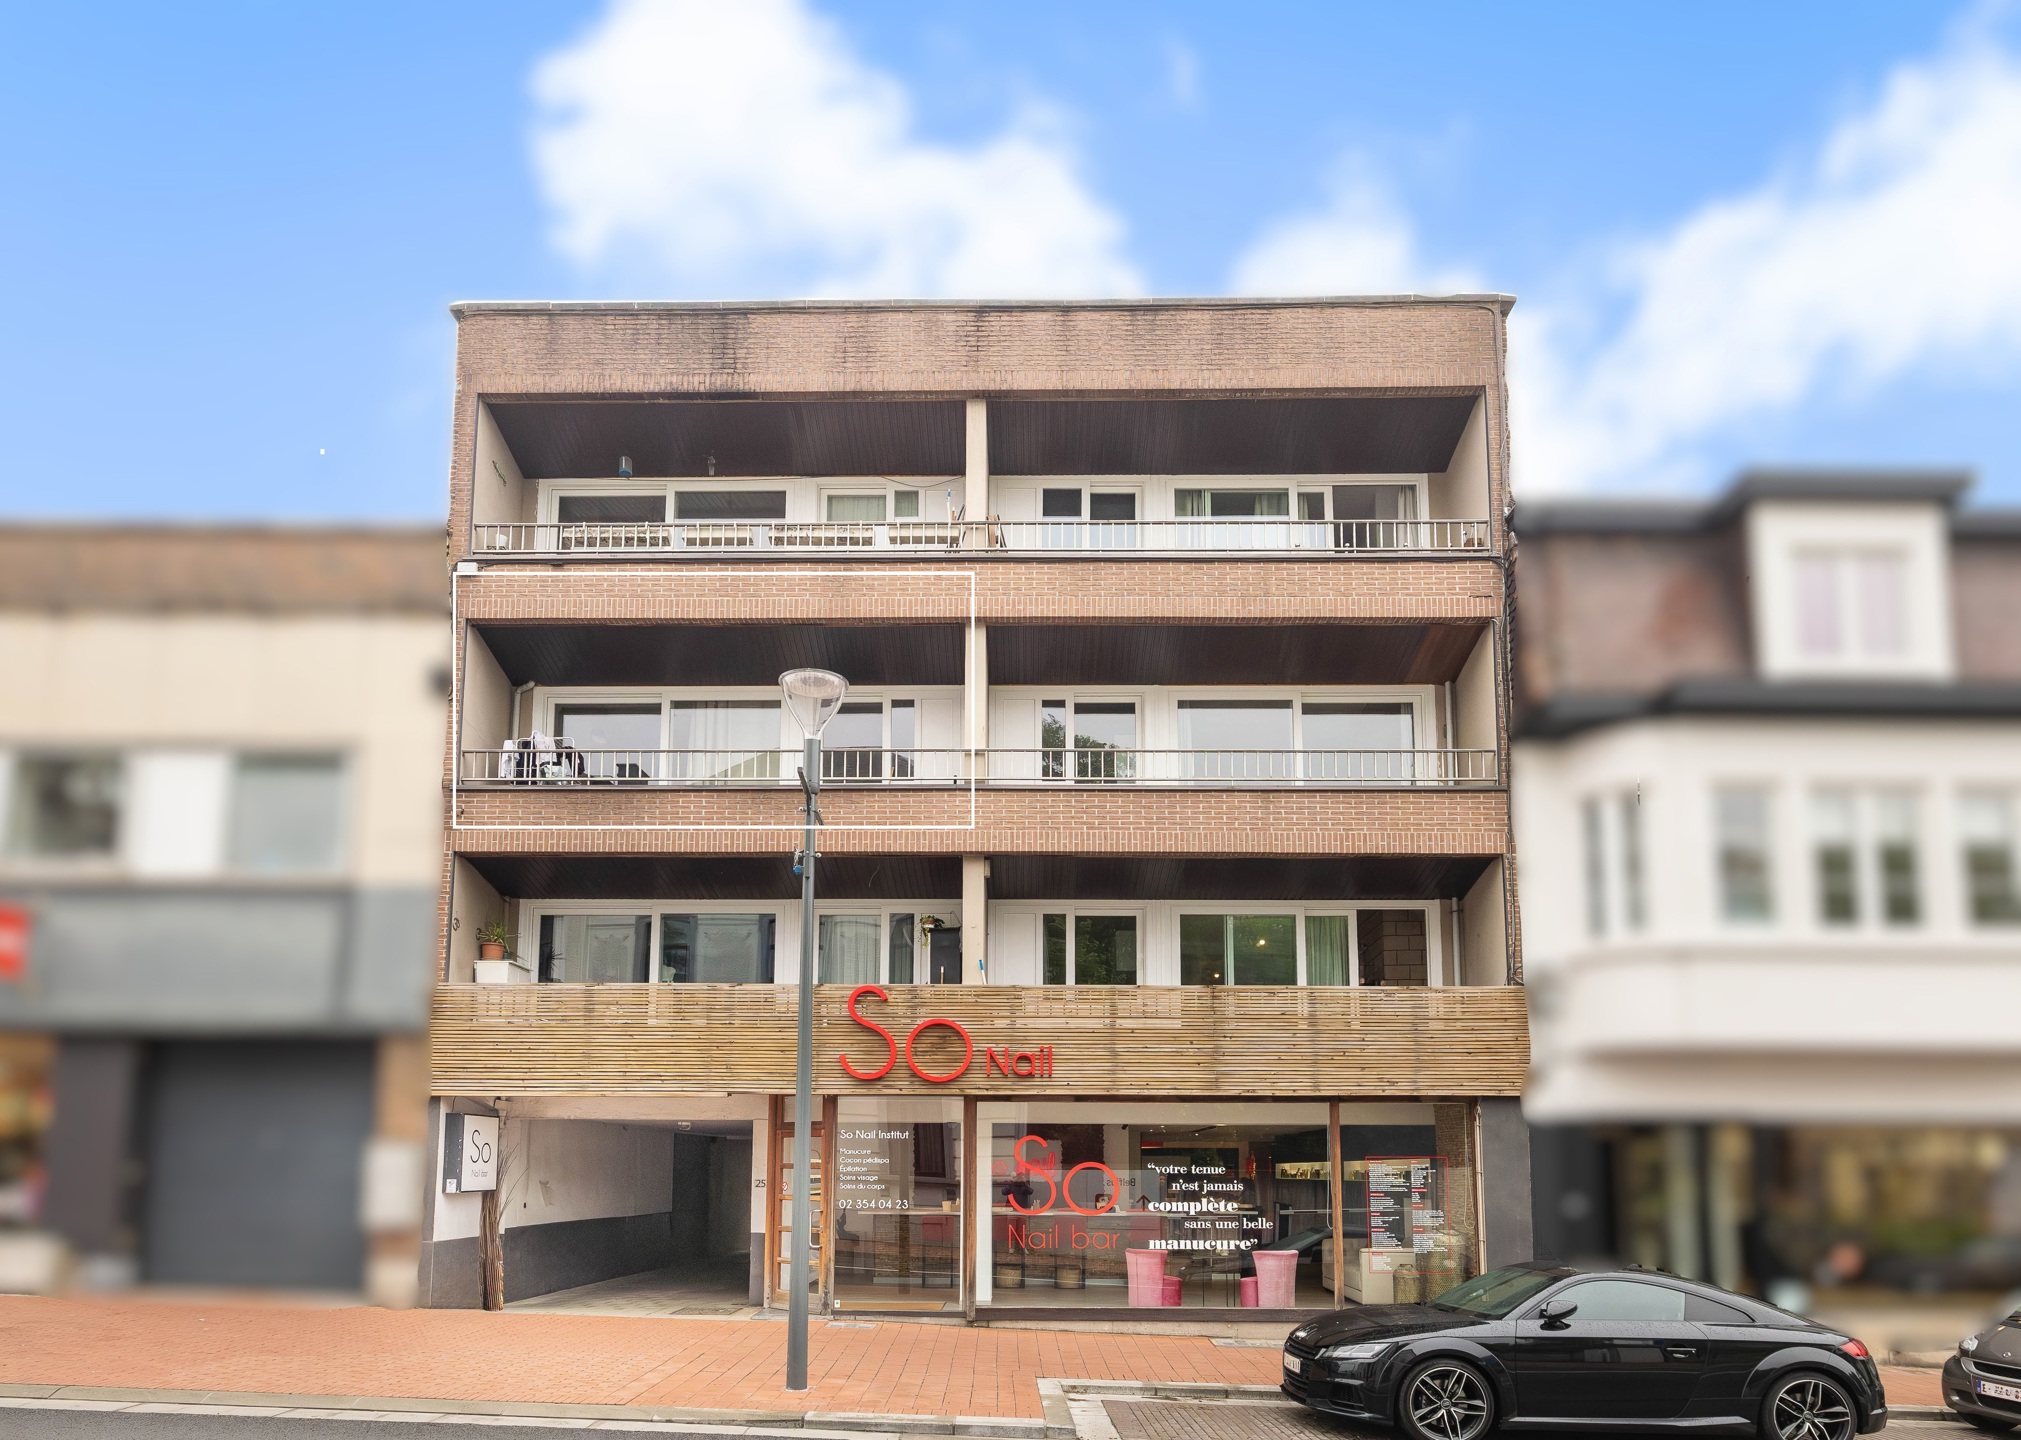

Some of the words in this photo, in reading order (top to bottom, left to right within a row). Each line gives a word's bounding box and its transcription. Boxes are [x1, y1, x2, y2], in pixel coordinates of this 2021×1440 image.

[839, 985, 973, 1082] So
[986, 1046, 1053, 1077] Nail
[840, 1129, 853, 1139] So
[855, 1129, 876, 1139] Nail
[878, 1129, 909, 1139] Institut
[470, 1129, 491, 1163] So
[1008, 1135, 1120, 1216] So
[1191, 1164, 1226, 1174] tenue
[755, 1179, 766, 1188] 25
[1172, 1179, 1199, 1191] n’est
[1202, 1180, 1244, 1195] jamais
[838, 1199, 852, 1209] 02
[855, 1199, 876, 1209] 354
[878, 1199, 892, 1209] 04
[895, 1199, 909, 1210] 23
[1148, 1197, 1238, 1216] complète
[1184, 1220, 1212, 1229] sans
[1215, 1220, 1239, 1229] une
[1242, 1217, 1274, 1229] belle
[1008, 1224, 1059, 1249] Nail
[1071, 1224, 1120, 1249] bar
